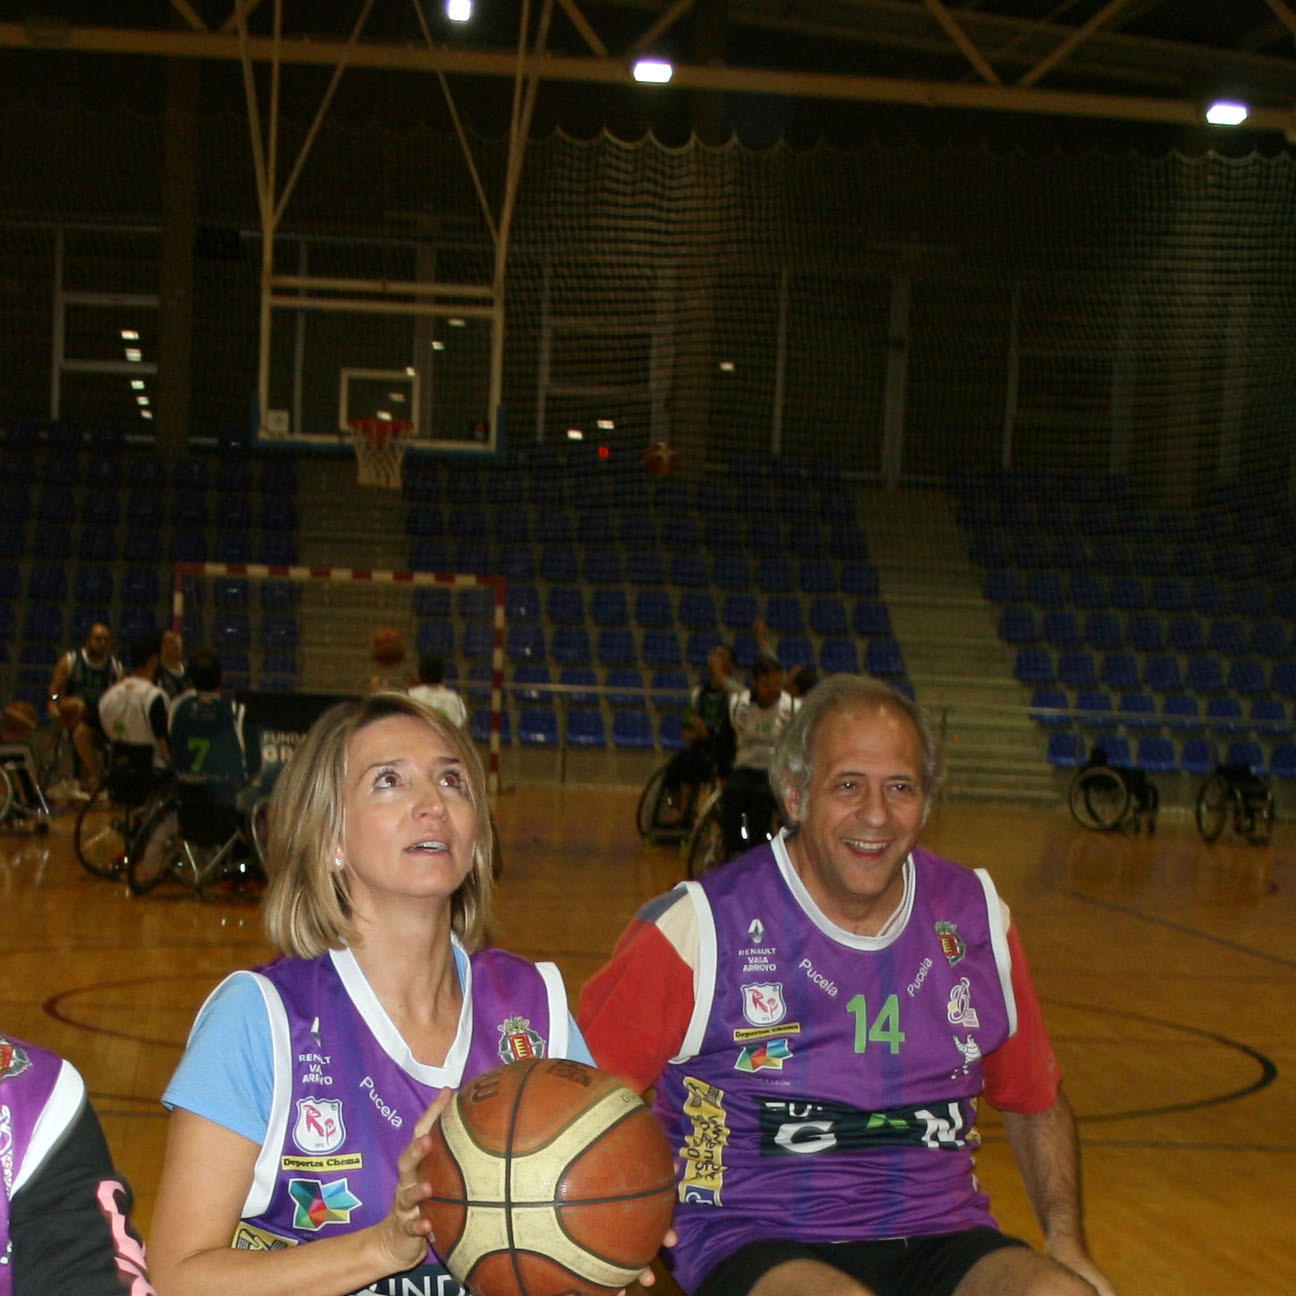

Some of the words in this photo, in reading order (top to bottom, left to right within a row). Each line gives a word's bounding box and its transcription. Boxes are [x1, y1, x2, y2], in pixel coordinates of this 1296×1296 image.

[798, 957, 839, 998] Pucela
[906, 957, 933, 998] Pucela
[845, 993, 906, 1055] 14
[359, 1075, 403, 1128] Pucela
[283, 1156, 324, 1170] Deportes
